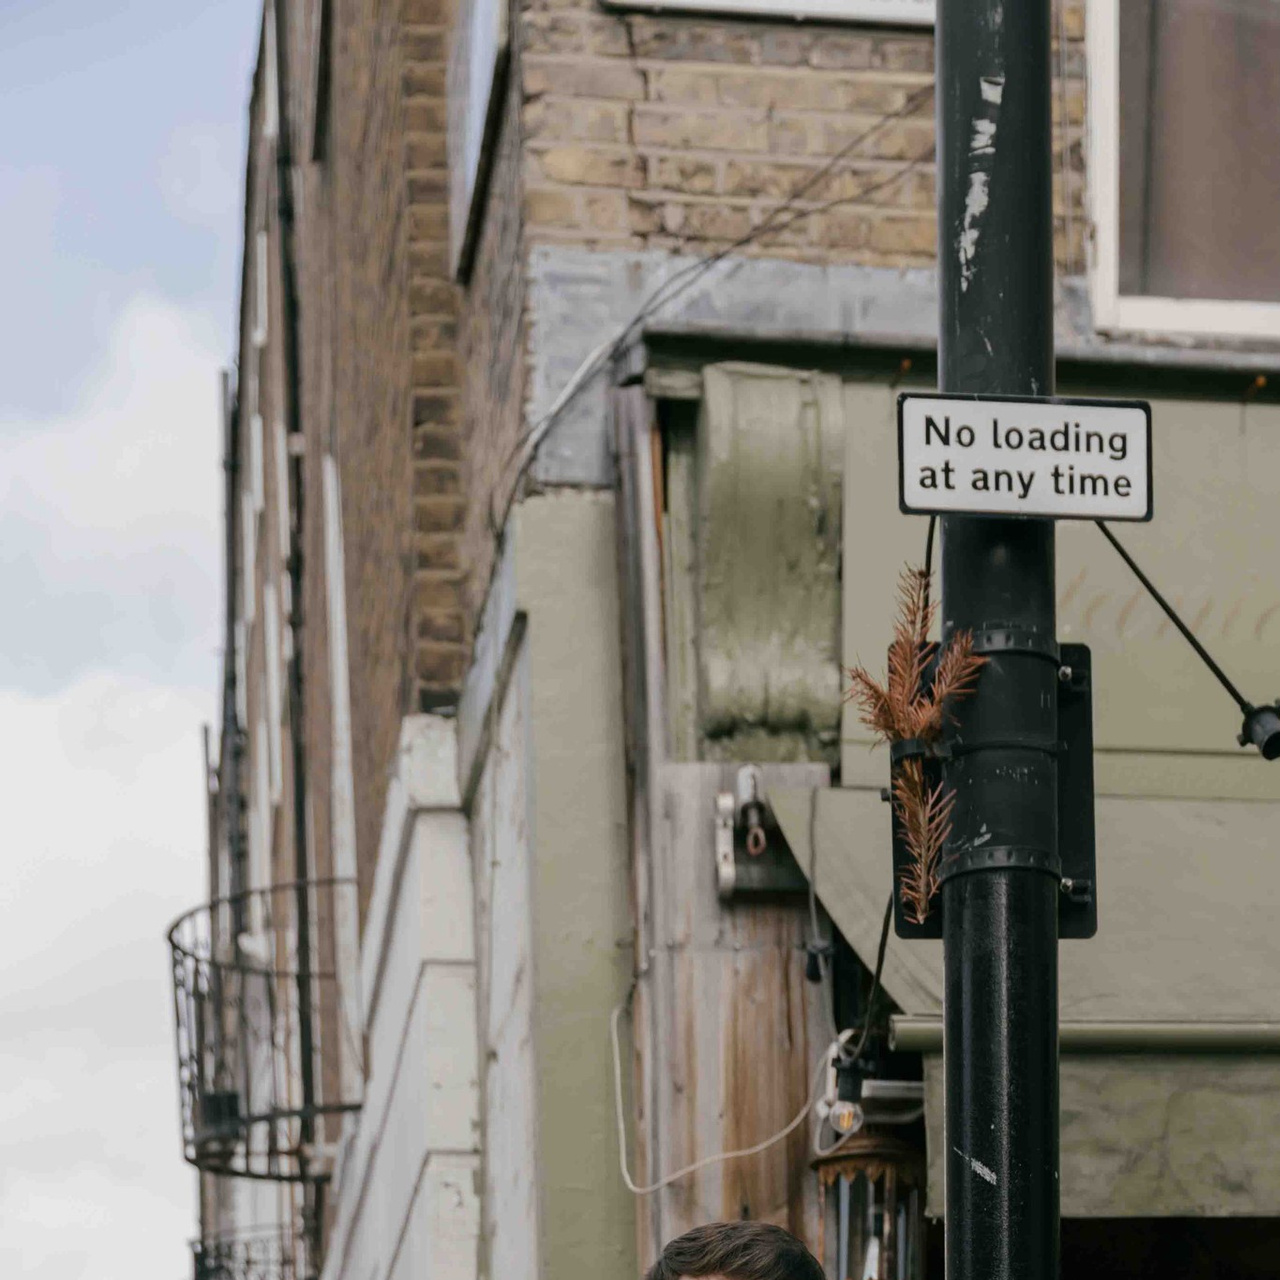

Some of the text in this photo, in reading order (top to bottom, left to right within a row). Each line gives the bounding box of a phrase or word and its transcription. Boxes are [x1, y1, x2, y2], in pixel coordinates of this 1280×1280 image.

[924, 415, 1129, 461] No loading
[919, 459, 1133, 499] at any time
